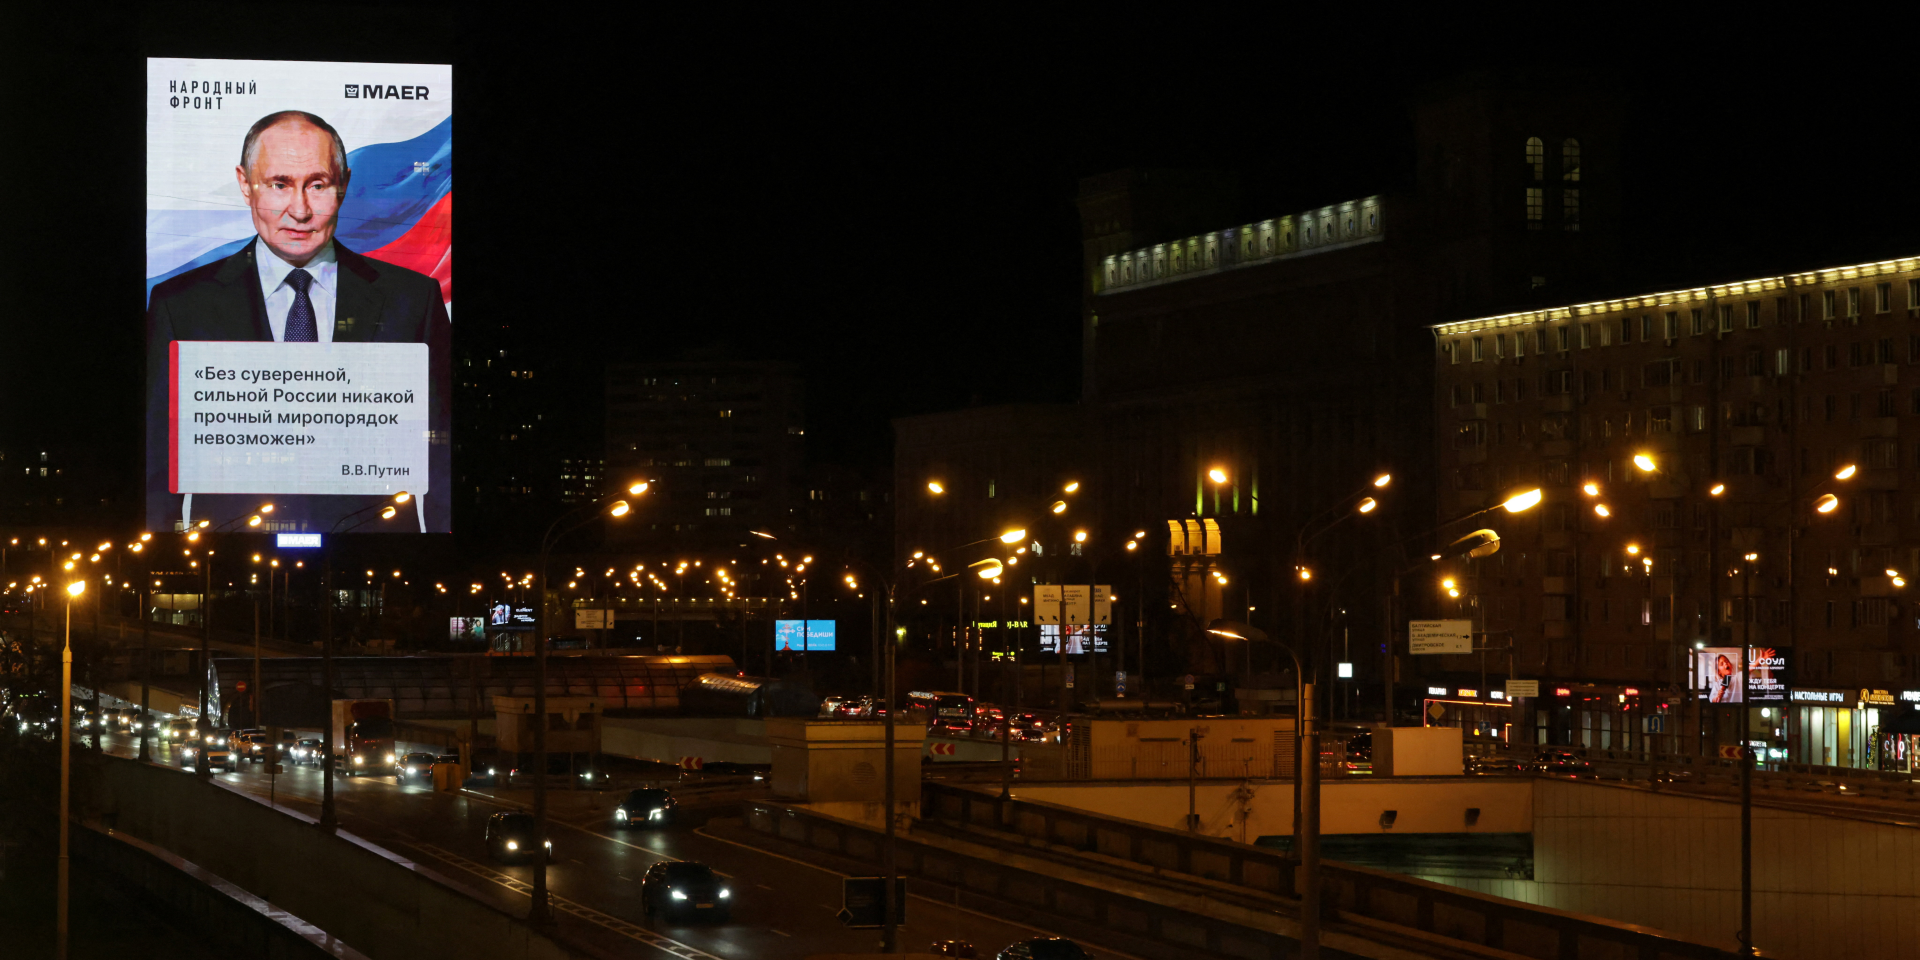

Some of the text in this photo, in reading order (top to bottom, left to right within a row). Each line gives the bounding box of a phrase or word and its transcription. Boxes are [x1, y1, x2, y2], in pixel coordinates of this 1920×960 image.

[169, 79, 257, 95] НАРОДНЫЙ
[363, 84, 430, 100] MAER
[169, 96, 223, 110] ФРОНТ
[194, 366, 352, 384] «Без суверенной,
[194, 388, 414, 404] сильной России никакой
[194, 410, 398, 428] прочный миропорядок
[194, 432, 316, 445] невозможен»
[341, 464, 410, 477] В.В.Путин
[288, 535, 319, 545] MAER
[1794, 691, 1828, 701] НАСТОЛЬНЫЕ
[1829, 692, 1844, 702] ИГРЫ
